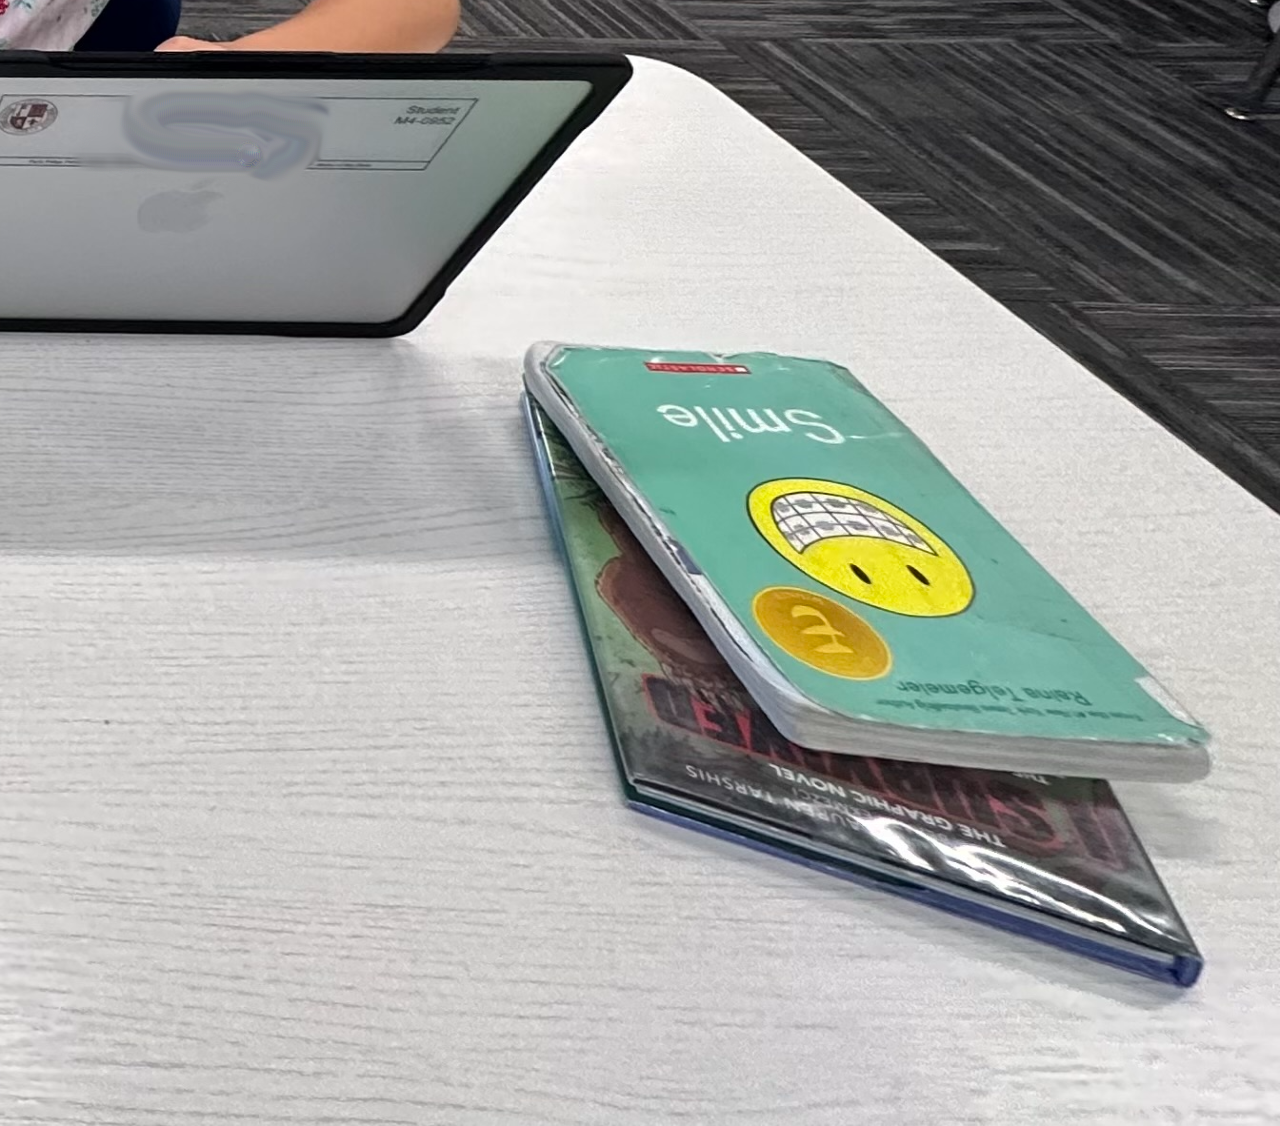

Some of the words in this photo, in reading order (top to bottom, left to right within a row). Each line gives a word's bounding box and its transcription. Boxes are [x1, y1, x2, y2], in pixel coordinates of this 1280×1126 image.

[406, 105, 462, 115] Student
[649, 363, 736, 373] SCHOLASTIC
[656, 404, 846, 445] Smile
[897, 679, 1024, 702] Telgemeier
[1021, 685, 1093, 706] Raina
[685, 763, 775, 806] TARSHIS
[768, 763, 847, 798] NOVEL
[782, 796, 865, 831] AUREN
[855, 789, 955, 834] GRAPHIC
[959, 824, 1006, 849] THE
